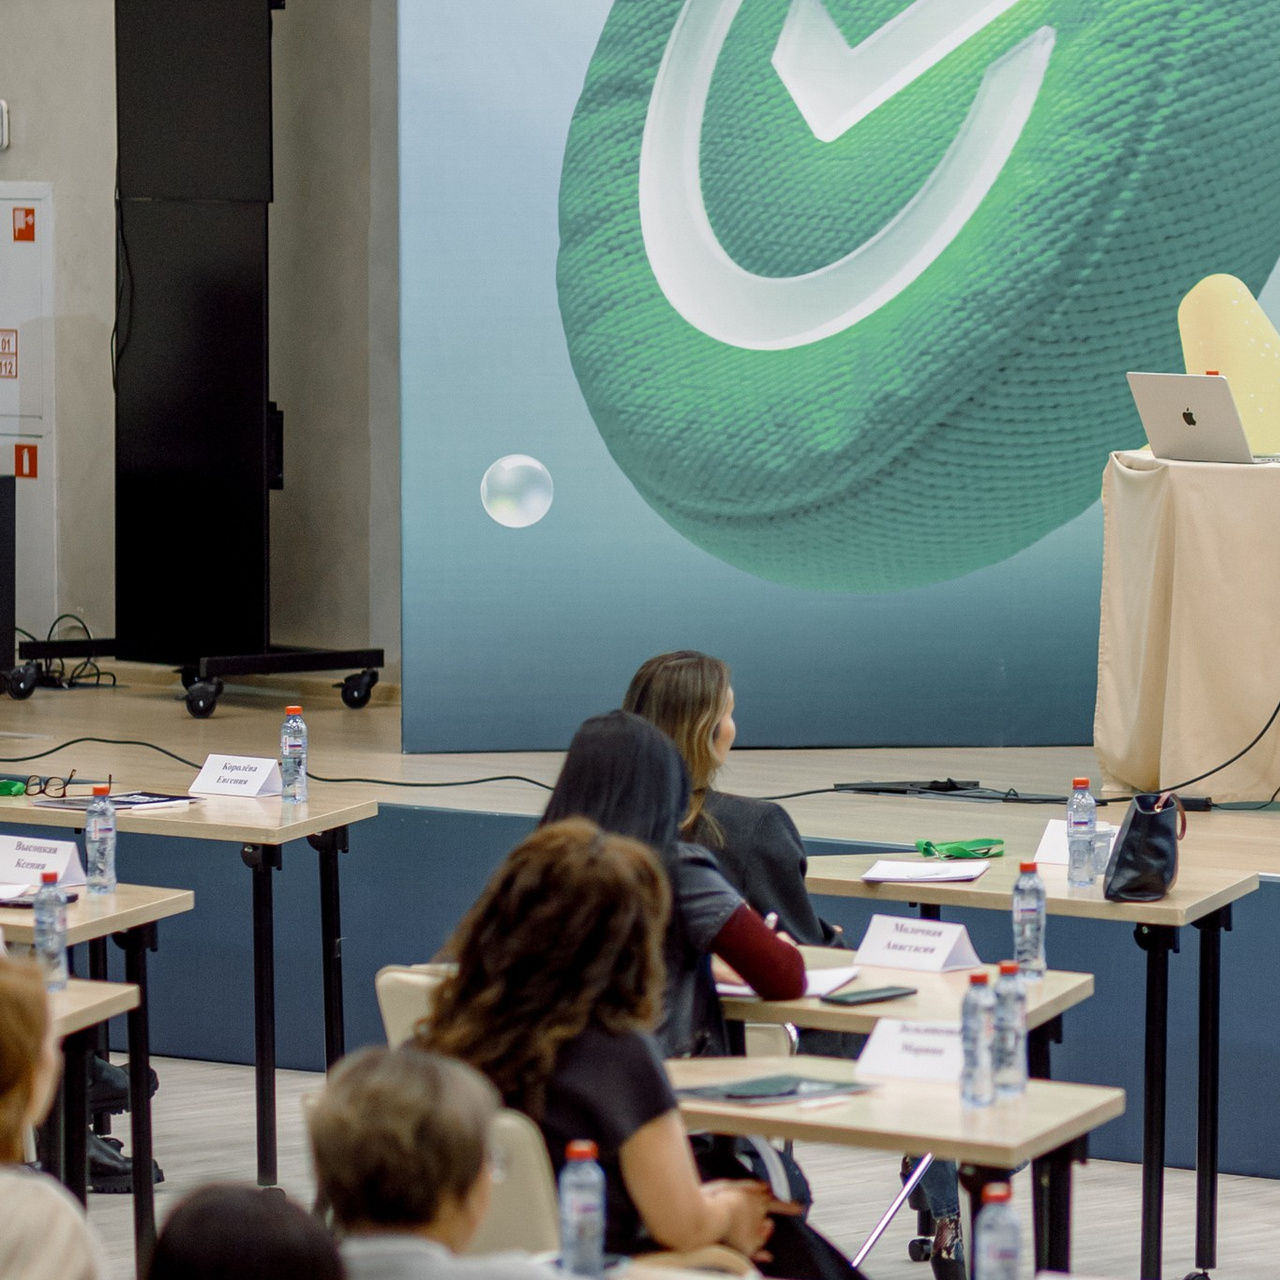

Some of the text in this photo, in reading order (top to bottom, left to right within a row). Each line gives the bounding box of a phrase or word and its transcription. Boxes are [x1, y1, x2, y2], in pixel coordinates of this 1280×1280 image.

[1, 338, 10, 351] 01
[222, 762, 258, 773] Королёва
[216, 775, 249, 785] Евгения
[15, 858, 47, 870] Ксения
